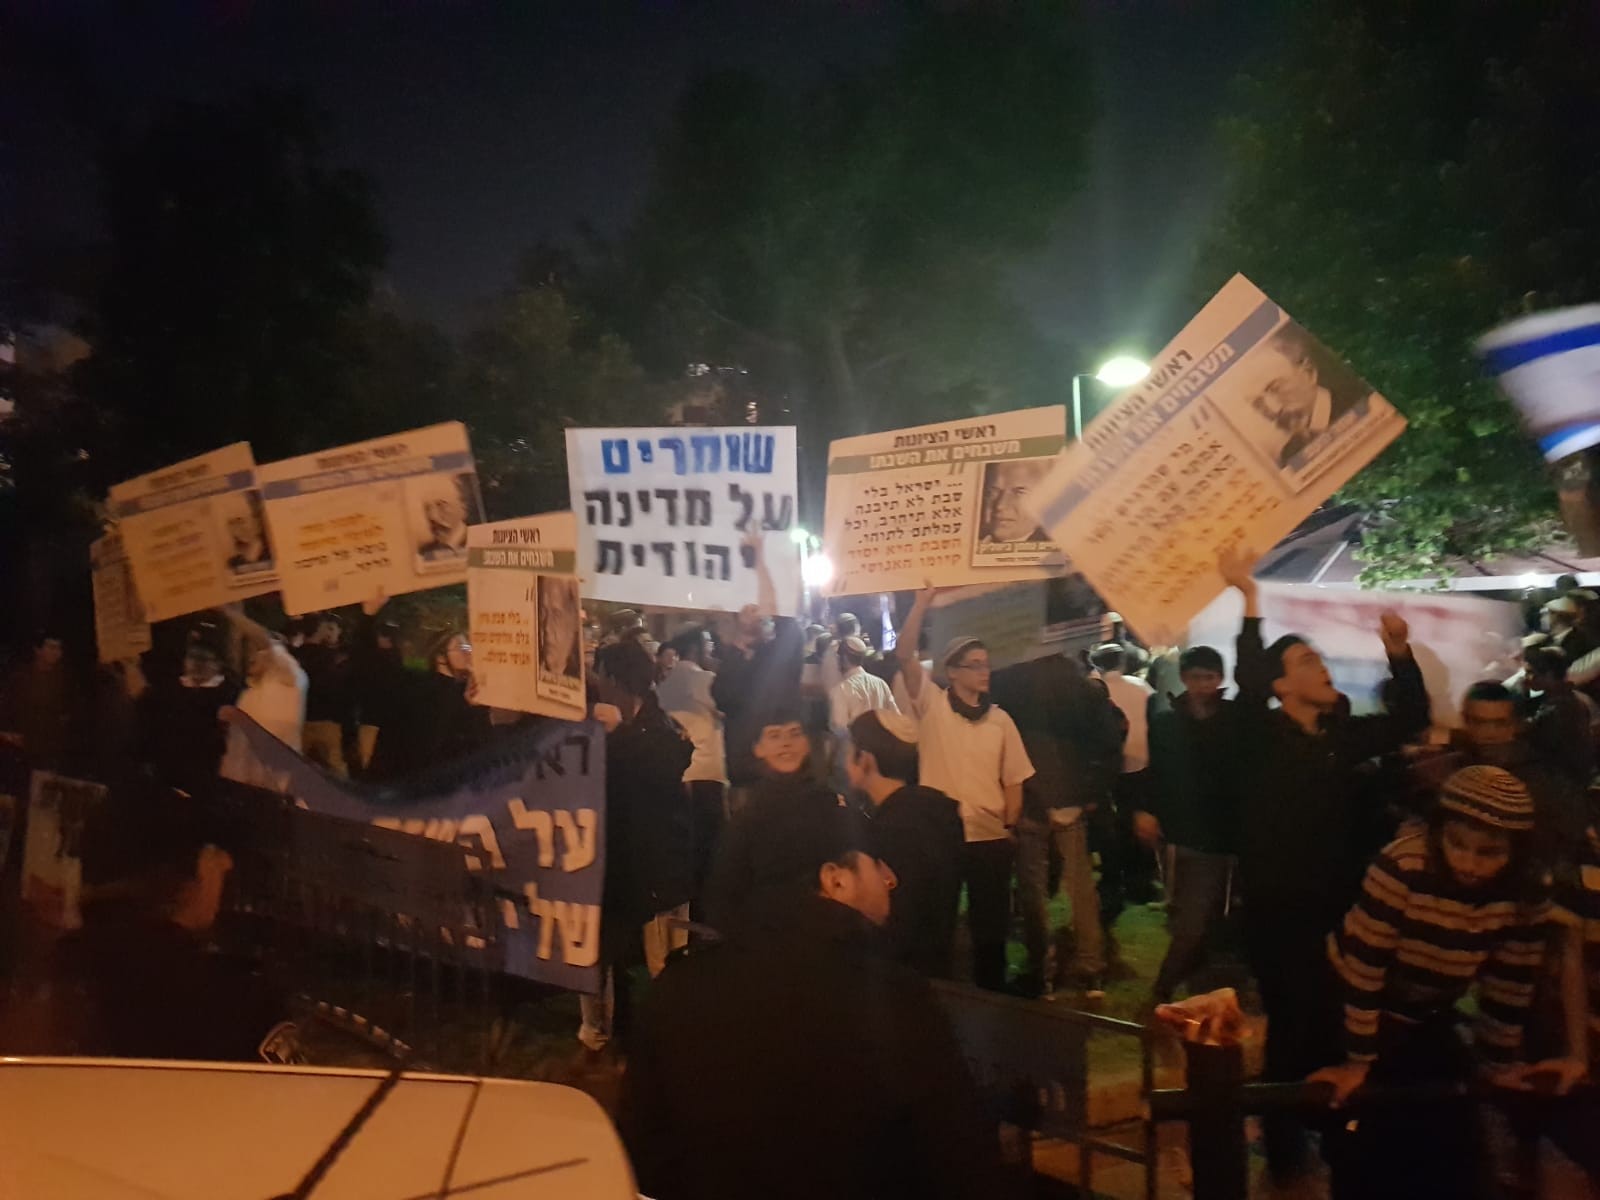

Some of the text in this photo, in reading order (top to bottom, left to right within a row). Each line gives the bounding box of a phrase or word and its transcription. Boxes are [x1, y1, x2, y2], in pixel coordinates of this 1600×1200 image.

[1144, 348, 1192, 394] ראשי
[1158, 342, 1233, 413] משבחים
[894, 424, 996, 448] ראשי הציונות
[601, 432, 775, 475] שומרים
[924, 449, 948, 462] את
[952, 440, 1021, 459] משבחים
[864, 486, 888, 498] בלי
[896, 480, 940, 495] ישראל
[584, 483, 793, 531] על מדינה
[856, 492, 963, 515] שבת לא תיבנה
[932, 506, 963, 519] אלא
[844, 518, 868, 532] וכל
[519, 527, 541, 544] ראשי
[920, 538, 961, 552] השבת
[886, 543, 913, 556] היא
[595, 540, 757, 581] יהודית
[919, 554, 961, 568] קיומו
[508, 798, 597, 873] על
[524, 882, 601, 967] של
